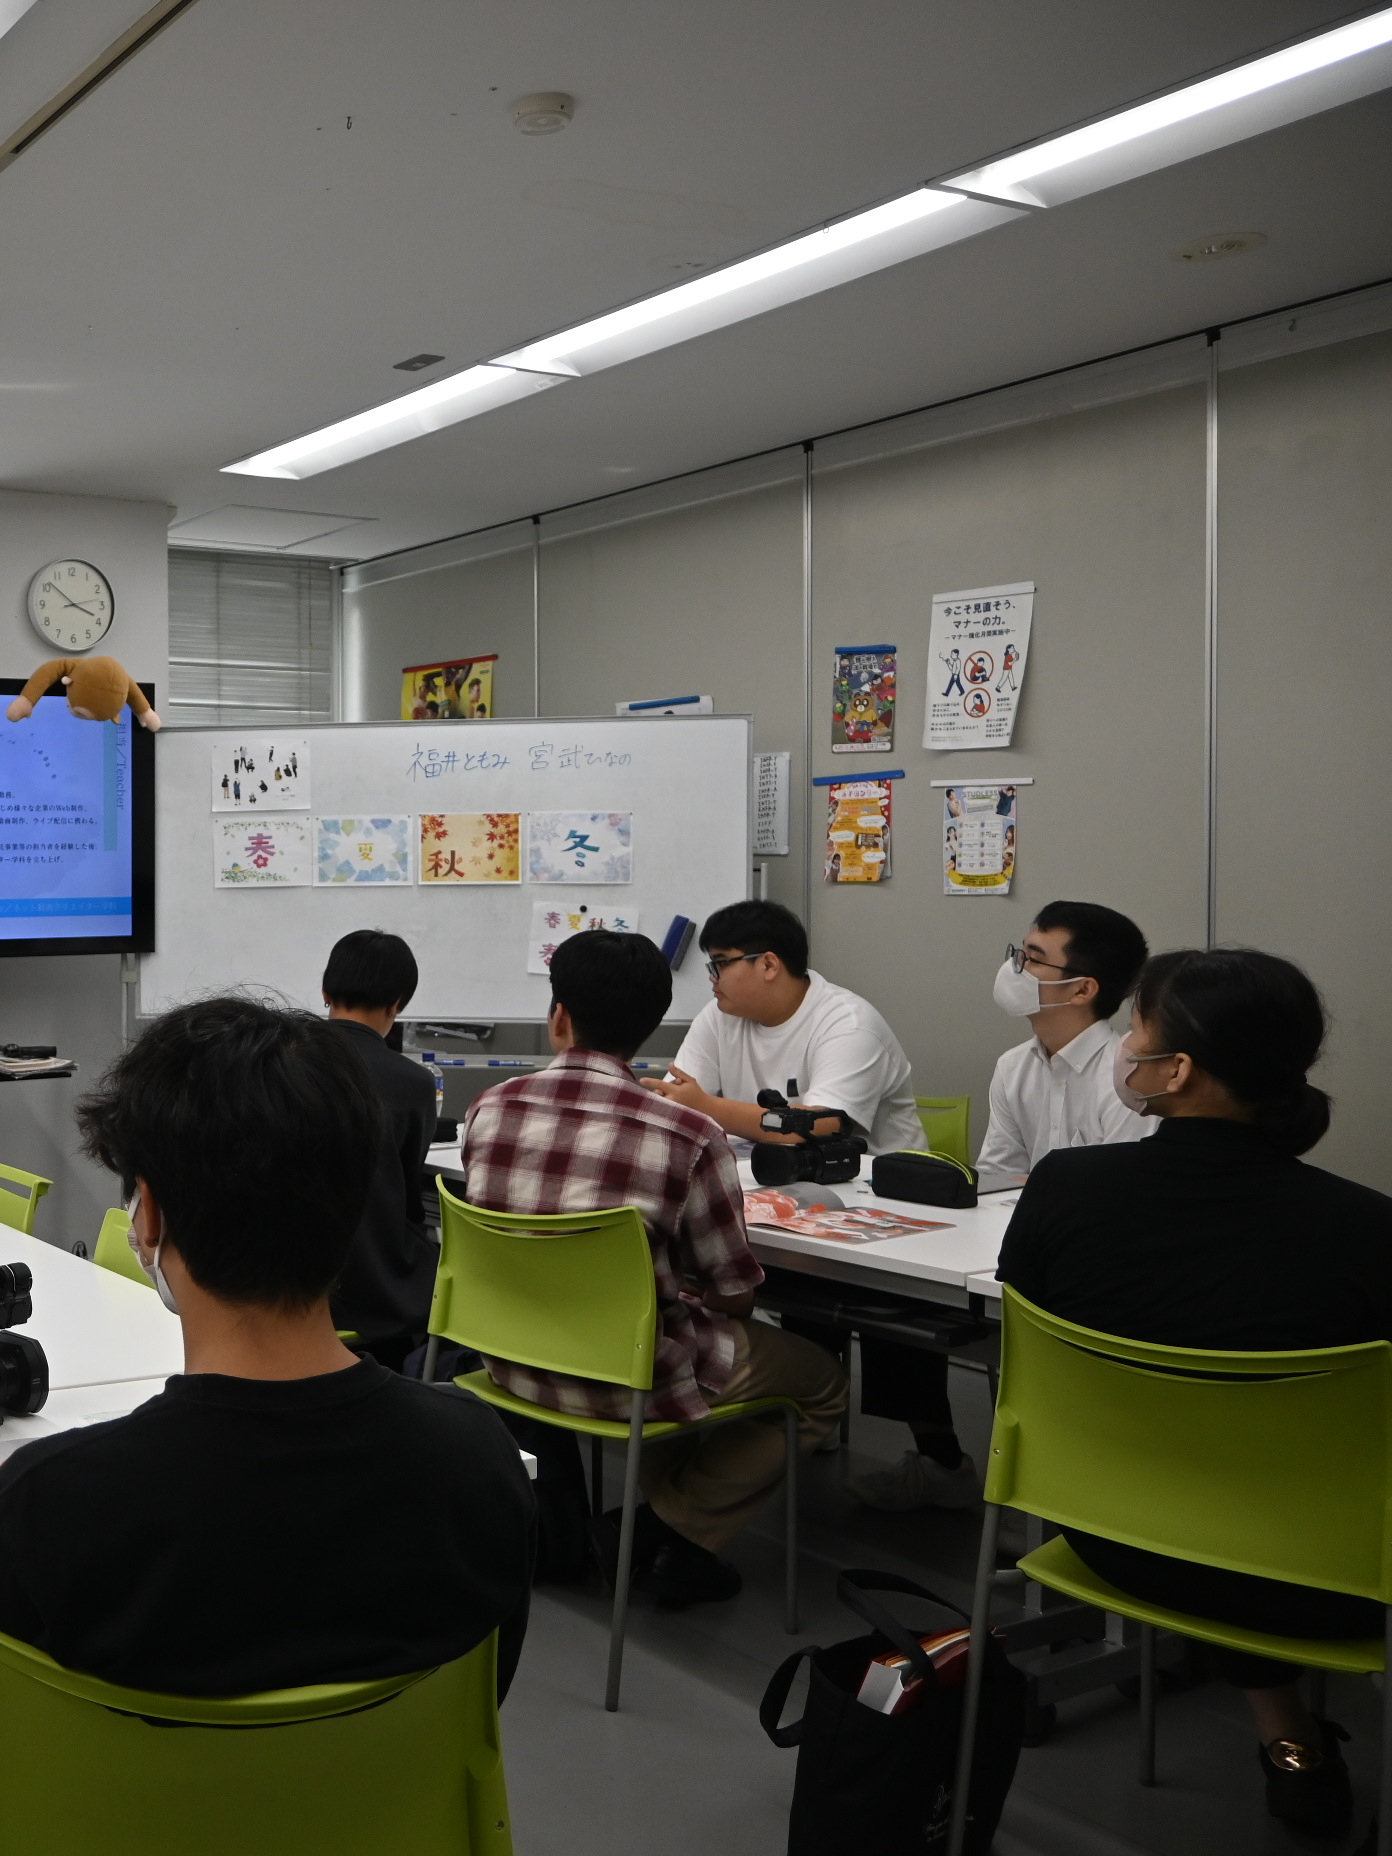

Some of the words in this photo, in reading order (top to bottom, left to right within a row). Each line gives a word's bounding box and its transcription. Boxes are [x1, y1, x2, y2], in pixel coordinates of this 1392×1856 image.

[53, 571, 61, 581] 11
[68, 566, 76, 577] 12
[42, 582, 51, 592] 10
[94, 584, 101, 594] 2
[39, 600, 46, 610] 9
[99, 600, 105, 611] 3
[943, 599, 1016, 617] 今こそ見直そう、
[43, 617, 51, 627] 8
[95, 617, 101, 627] 4
[952, 614, 1006, 629] マナーの力。
[55, 628, 62, 638] 7
[70, 633, 77, 643] 6
[85, 629, 92, 639] 5
[406, 743, 510, 783] 福井ともみ
[528, 741, 632, 771] 宮武ひなの
[244, 833, 276, 869] 春
[356, 842, 375, 861] 夏
[562, 829, 601, 868] 冬
[425, 849, 466, 878] 秋
[544, 911, 561, 929] 春
[567, 913, 584, 931] 夏
[587, 917, 607, 931] 秋
[612, 916, 630, 933] 冬
